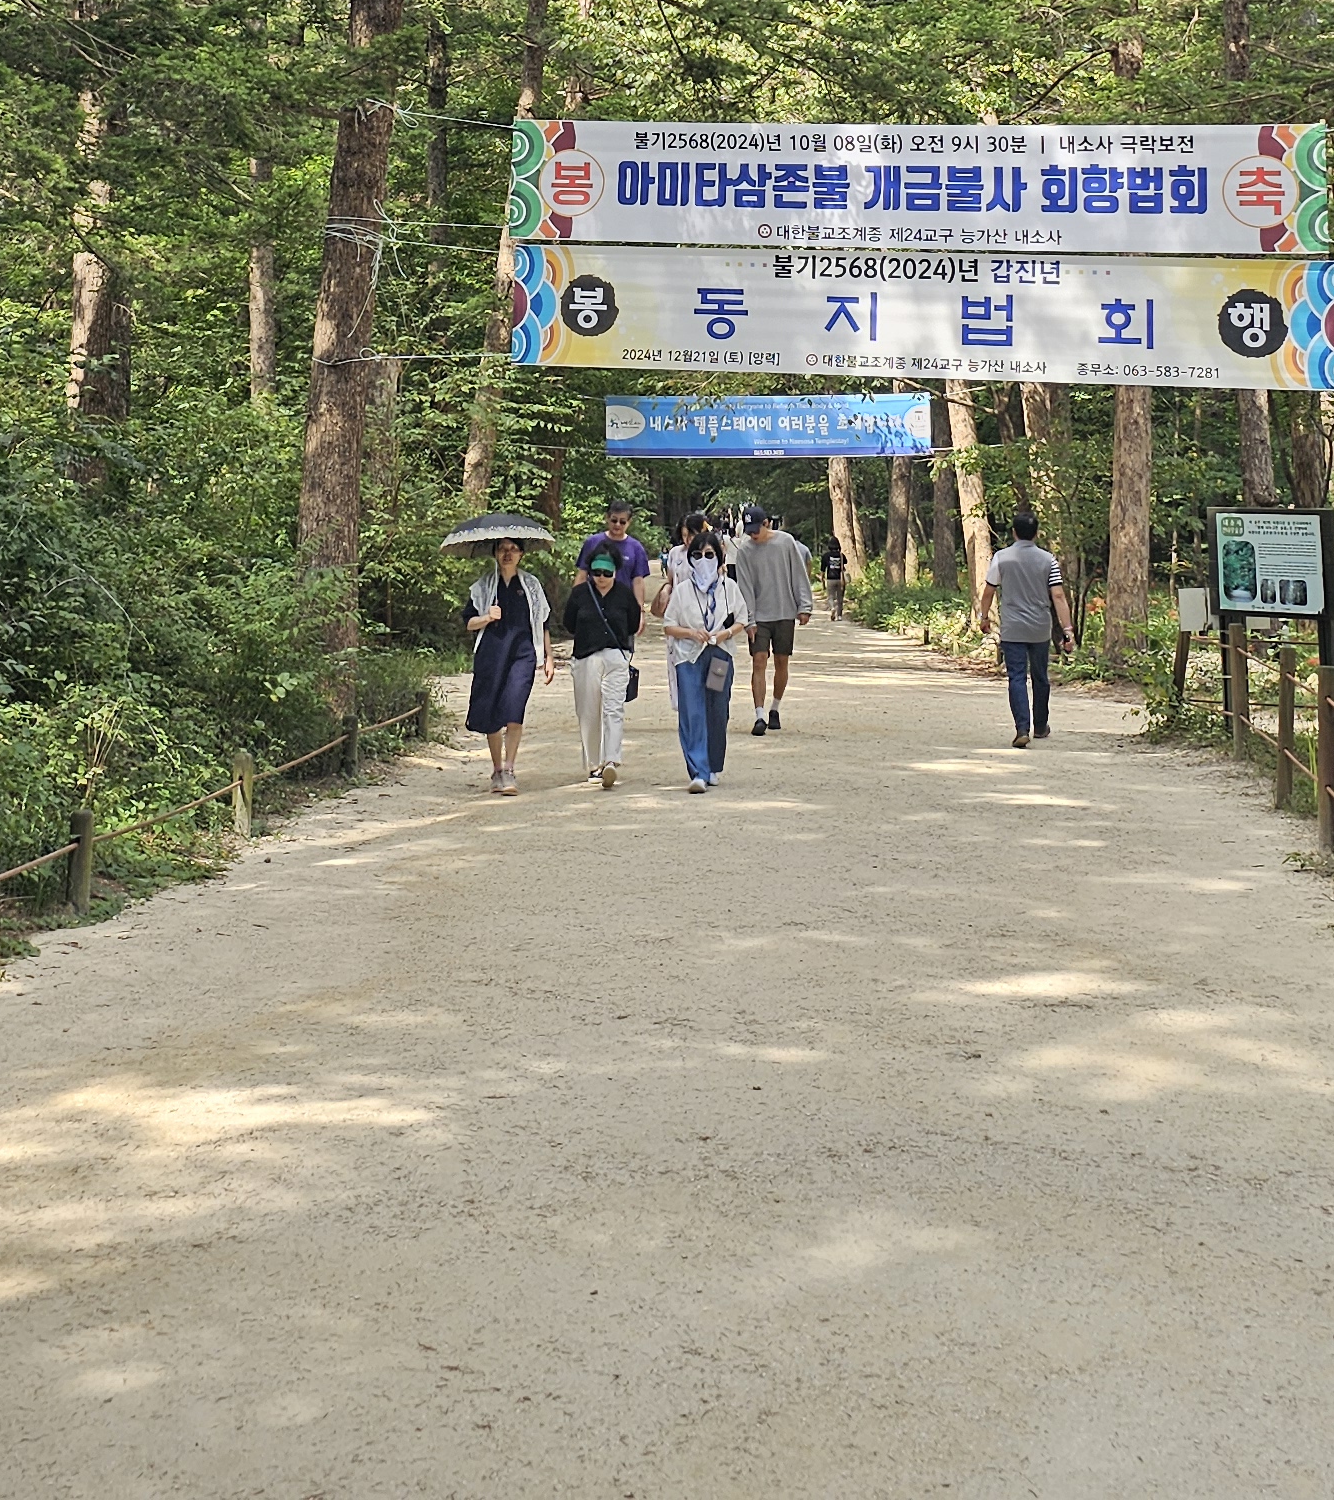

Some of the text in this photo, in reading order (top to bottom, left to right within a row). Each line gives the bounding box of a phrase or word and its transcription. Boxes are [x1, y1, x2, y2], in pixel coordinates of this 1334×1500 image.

[633, 131, 1194, 155] 불기2568(2024)년 10월 08일(화) 오전 9시 30분 내소사 극락보전
[551, 161, 594, 206] 봉
[617, 160, 1208, 215] 아미타삼존불 개금불사 회향법회
[1236, 166, 1285, 216] 축
[776, 223, 1063, 246] 대한불교조계종 제24교구 능가산 내소사
[772, 254, 1061, 285] 불기2568(2024)년 갑진년
[568, 287, 608, 329] 봉
[1227, 302, 1270, 348] 행
[621, 348, 780, 366] 2024년 12월21일 (토) [양력]
[822, 354, 1047, 375] 대한불교조계종 제24교구 능가산 내소사
[1076, 362, 1220, 379] 종무소: 063-583-7281
[693, 414, 772, 437] 템플스테이에
[777, 413, 830, 436] 여러분을
